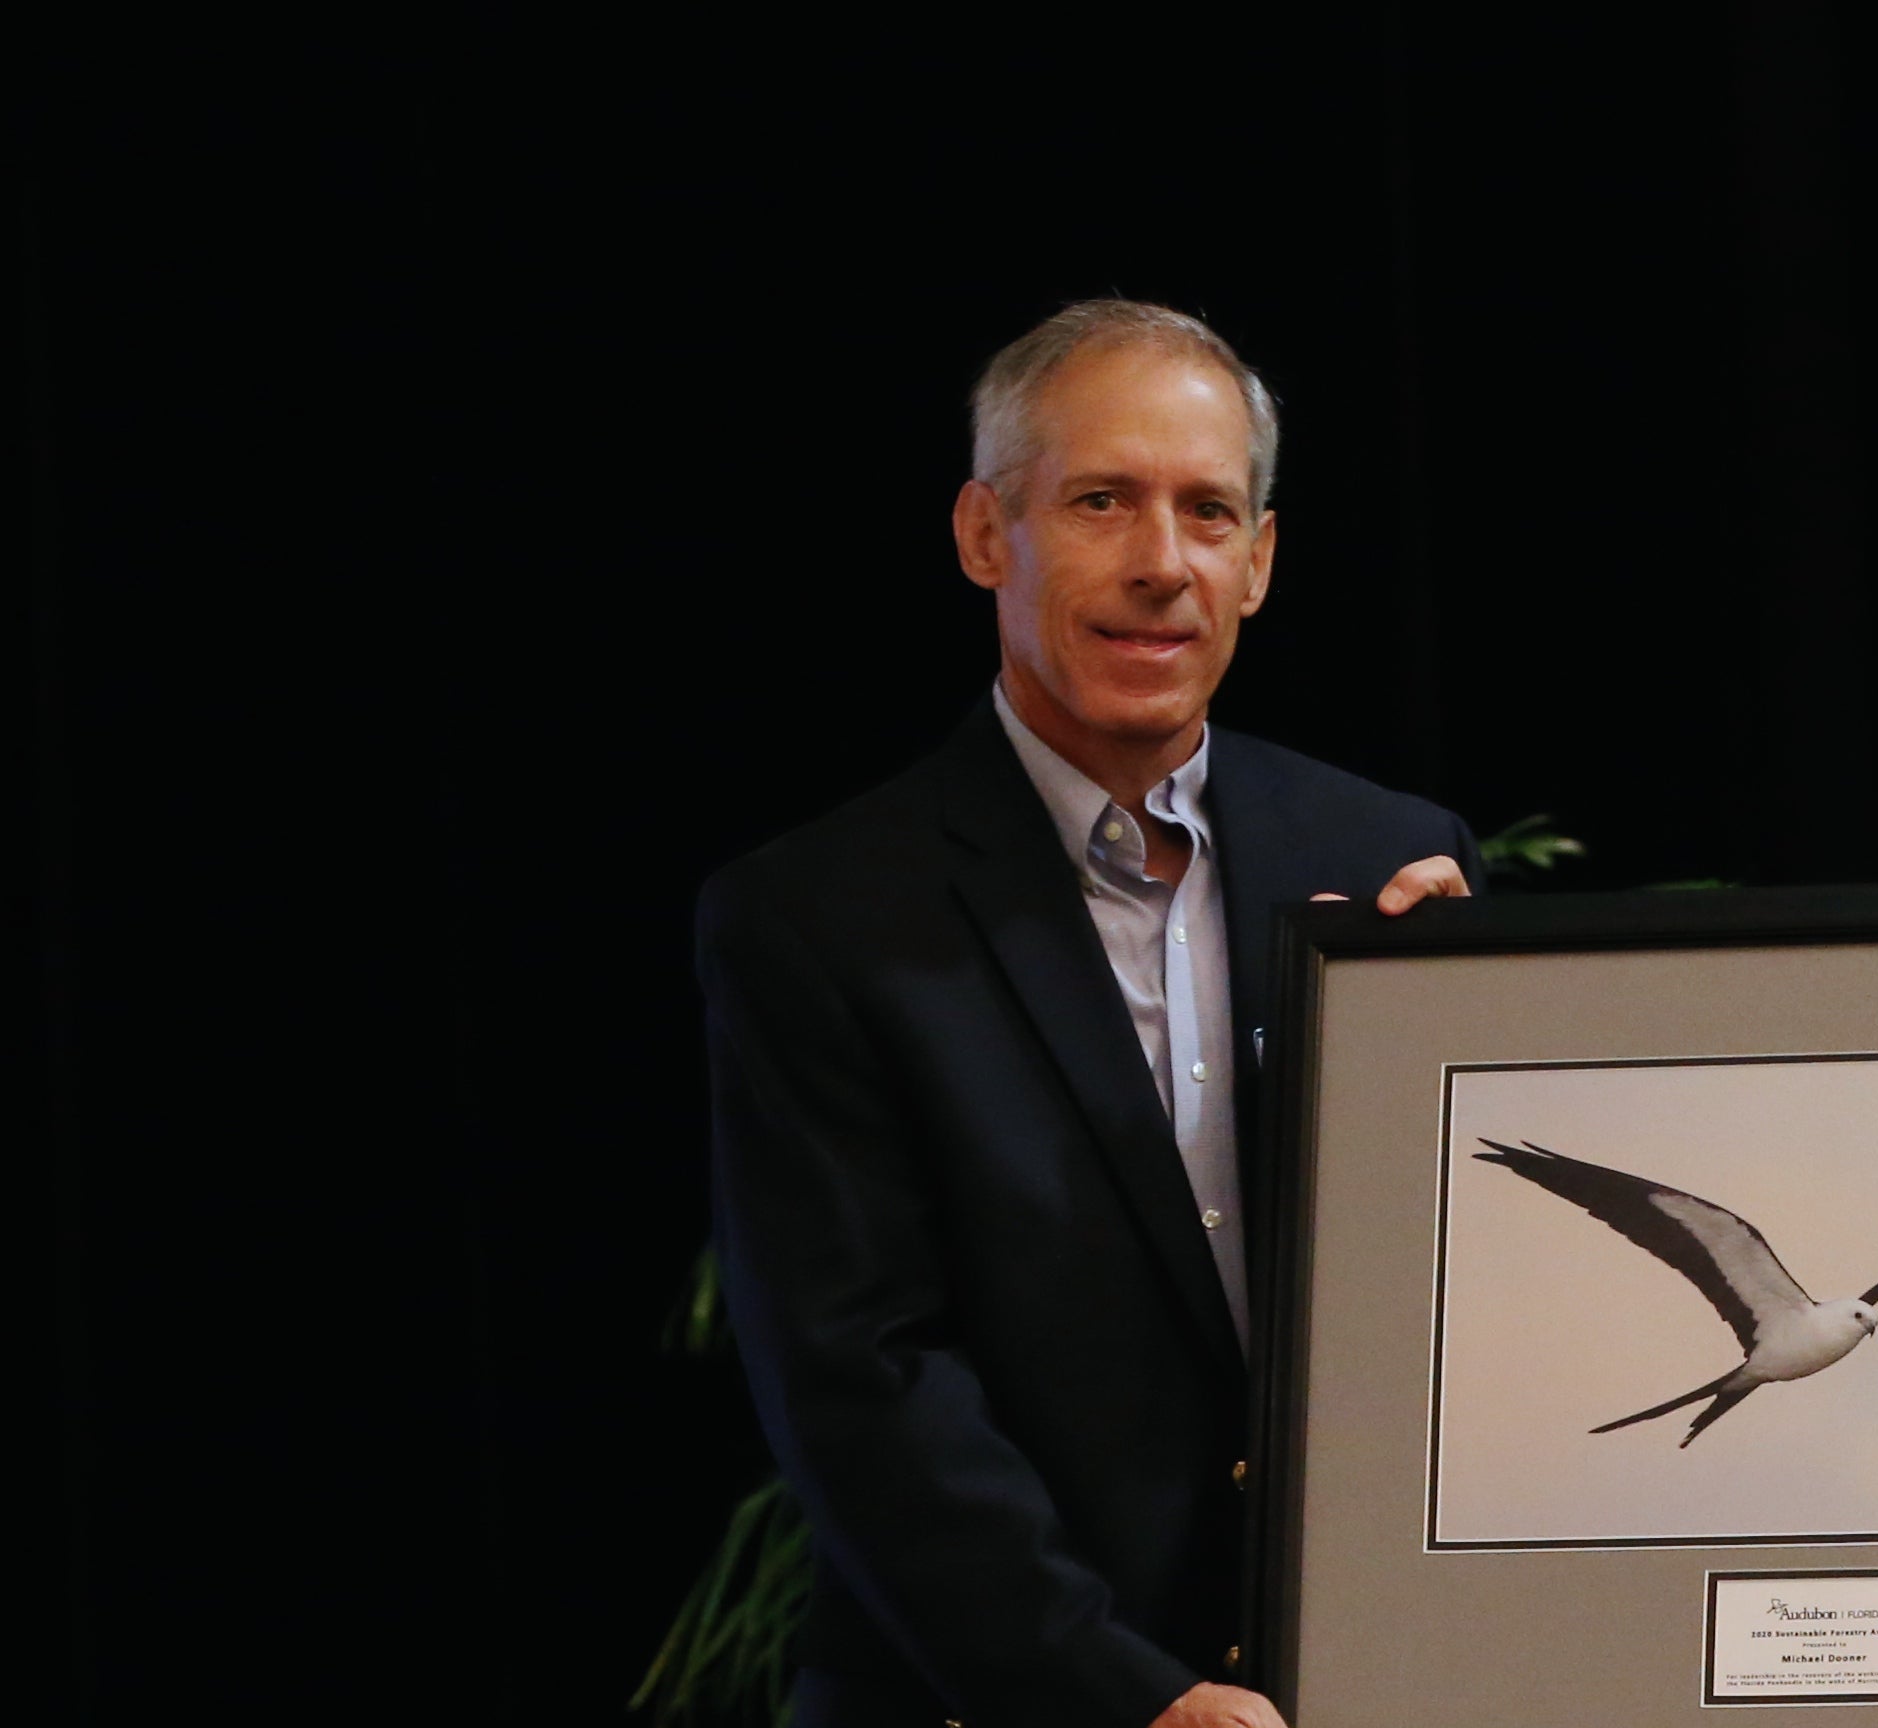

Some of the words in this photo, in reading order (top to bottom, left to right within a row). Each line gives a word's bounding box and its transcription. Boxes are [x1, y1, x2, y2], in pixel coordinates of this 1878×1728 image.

[1780, 1607, 1837, 1620] Audubon
[1776, 1629, 1827, 1638] Sustainable
[1830, 1629, 1867, 1637] Forestry
[1781, 1654, 1824, 1663] Michael
[1828, 1653, 1867, 1663] Dooner
